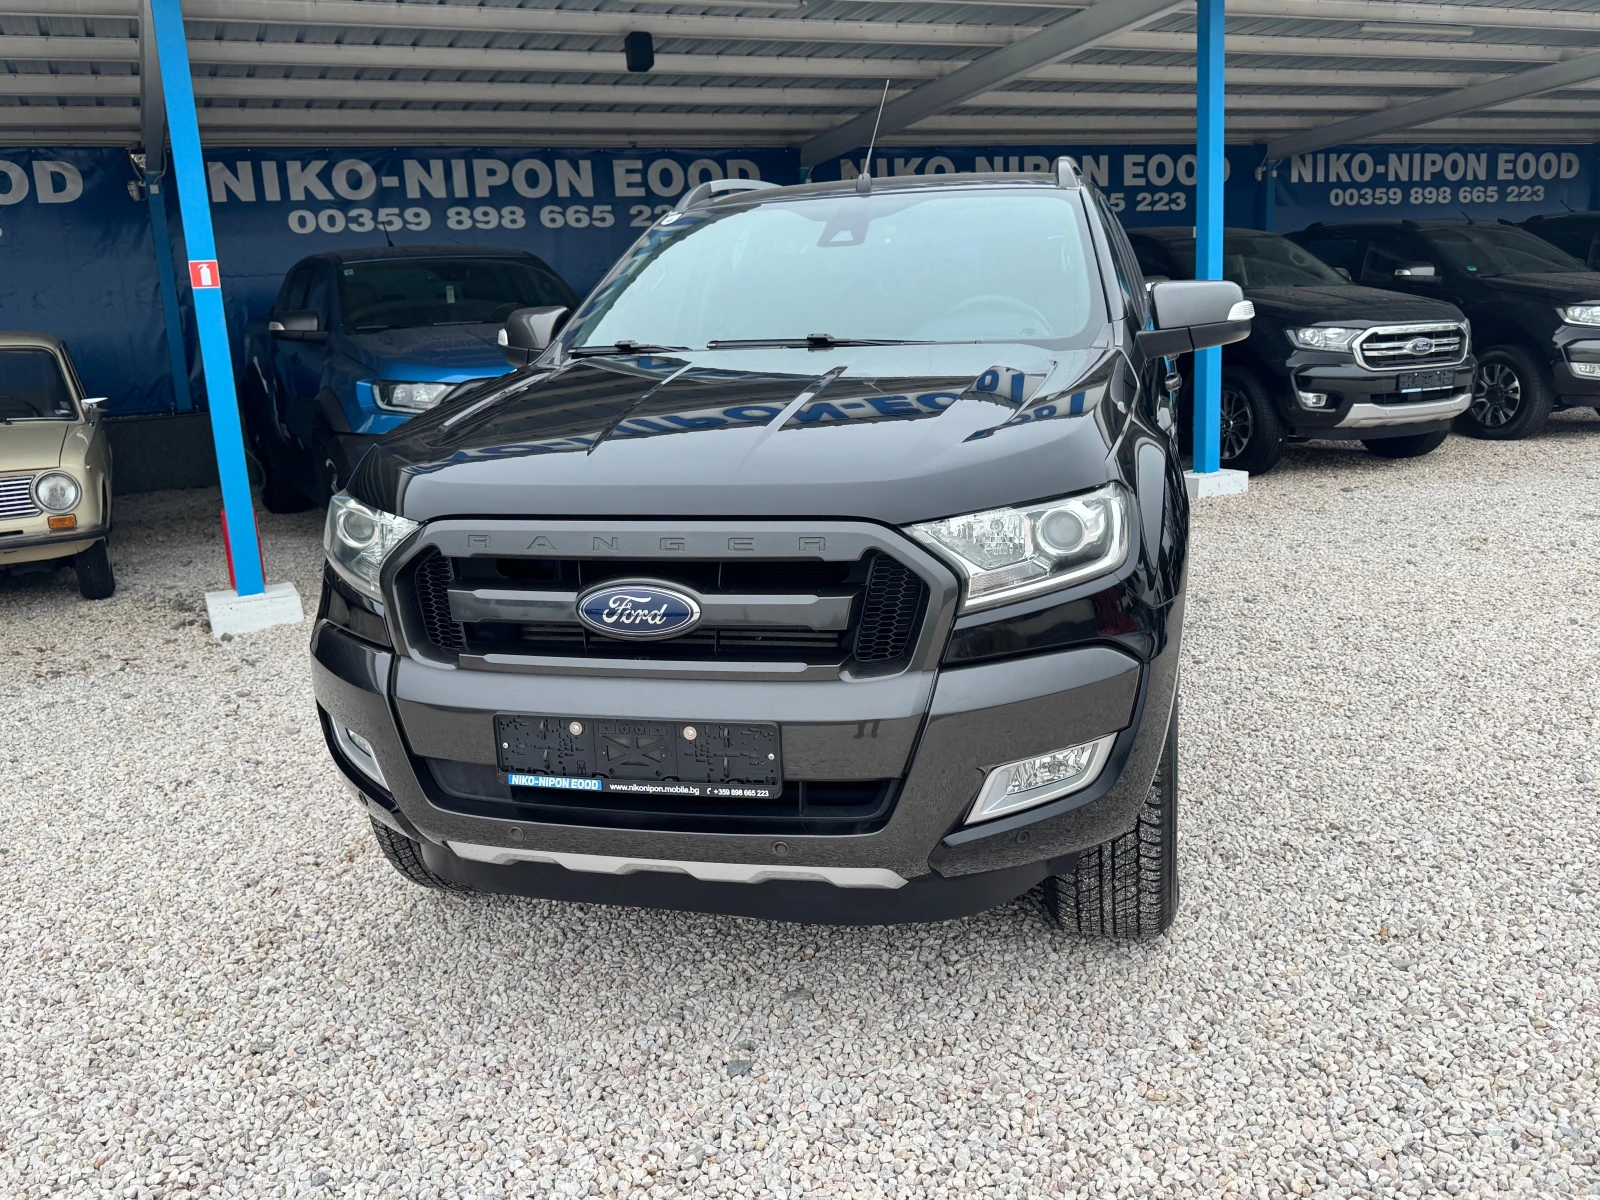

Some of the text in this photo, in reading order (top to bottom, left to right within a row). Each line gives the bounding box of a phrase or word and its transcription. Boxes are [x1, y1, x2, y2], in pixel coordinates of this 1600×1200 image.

[207, 158, 761, 202] NIKO-NIPON EOOD
[1123, 153, 1231, 187] EOO
[1290, 152, 1580, 183] NIKO-NIPON EOOD
[1135, 192, 1187, 212] 223
[1329, 185, 1545, 206] 00359 898 665 223
[287, 207, 431, 234] 00359
[446, 206, 526, 231] 898
[539, 204, 615, 229] 665
[466, 534, 826, 552] RANGER
[602, 594, 668, 625] Ford
[511, 774, 599, 790] NIKO-NIPON EOOD
[609, 783, 700, 796] www.nikonipon.mobile.bg
[730, 789, 743, 797] 898
